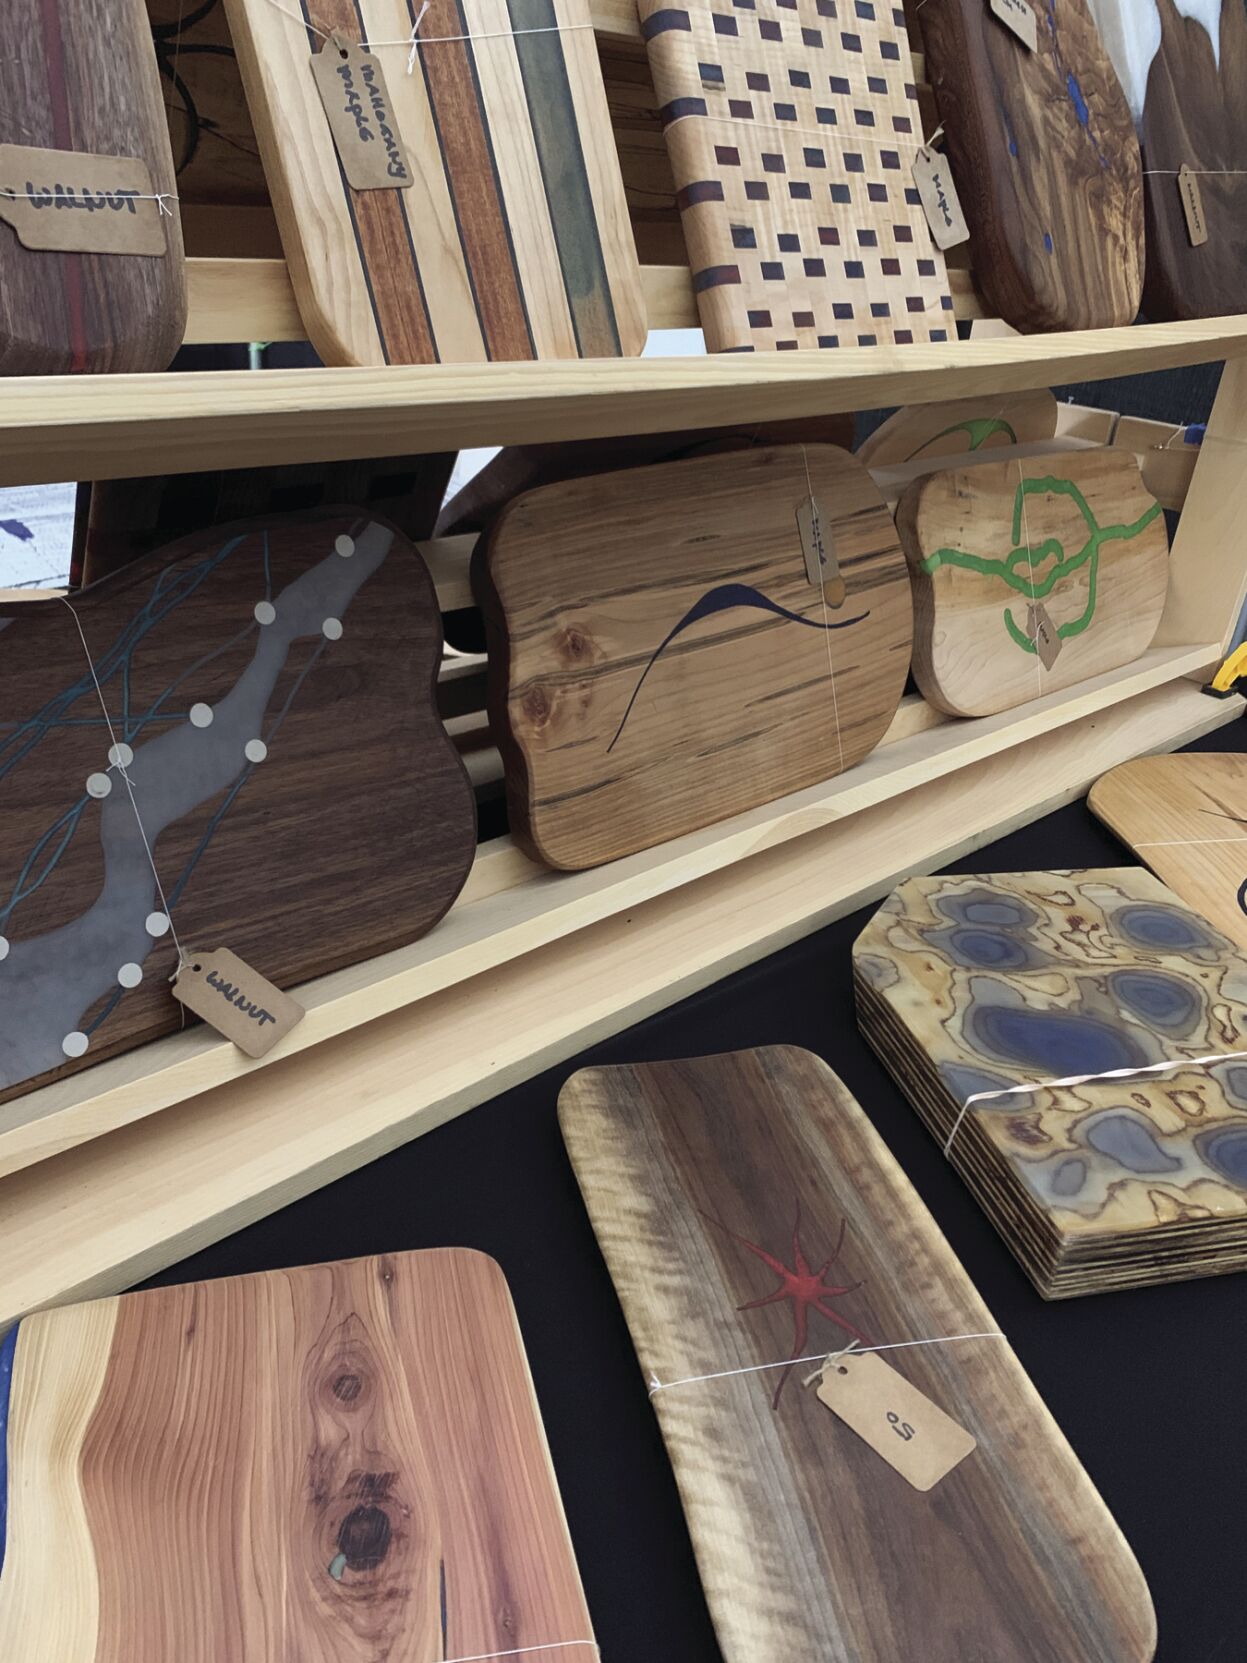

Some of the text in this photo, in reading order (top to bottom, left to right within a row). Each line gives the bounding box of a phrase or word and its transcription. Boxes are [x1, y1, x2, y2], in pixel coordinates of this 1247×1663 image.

[360, 63, 407, 179] MAHOGANY
[26, 181, 140, 214] WALNUT
[206, 970, 276, 1026] WALNUT
[886, 1411, 916, 1441] 50
